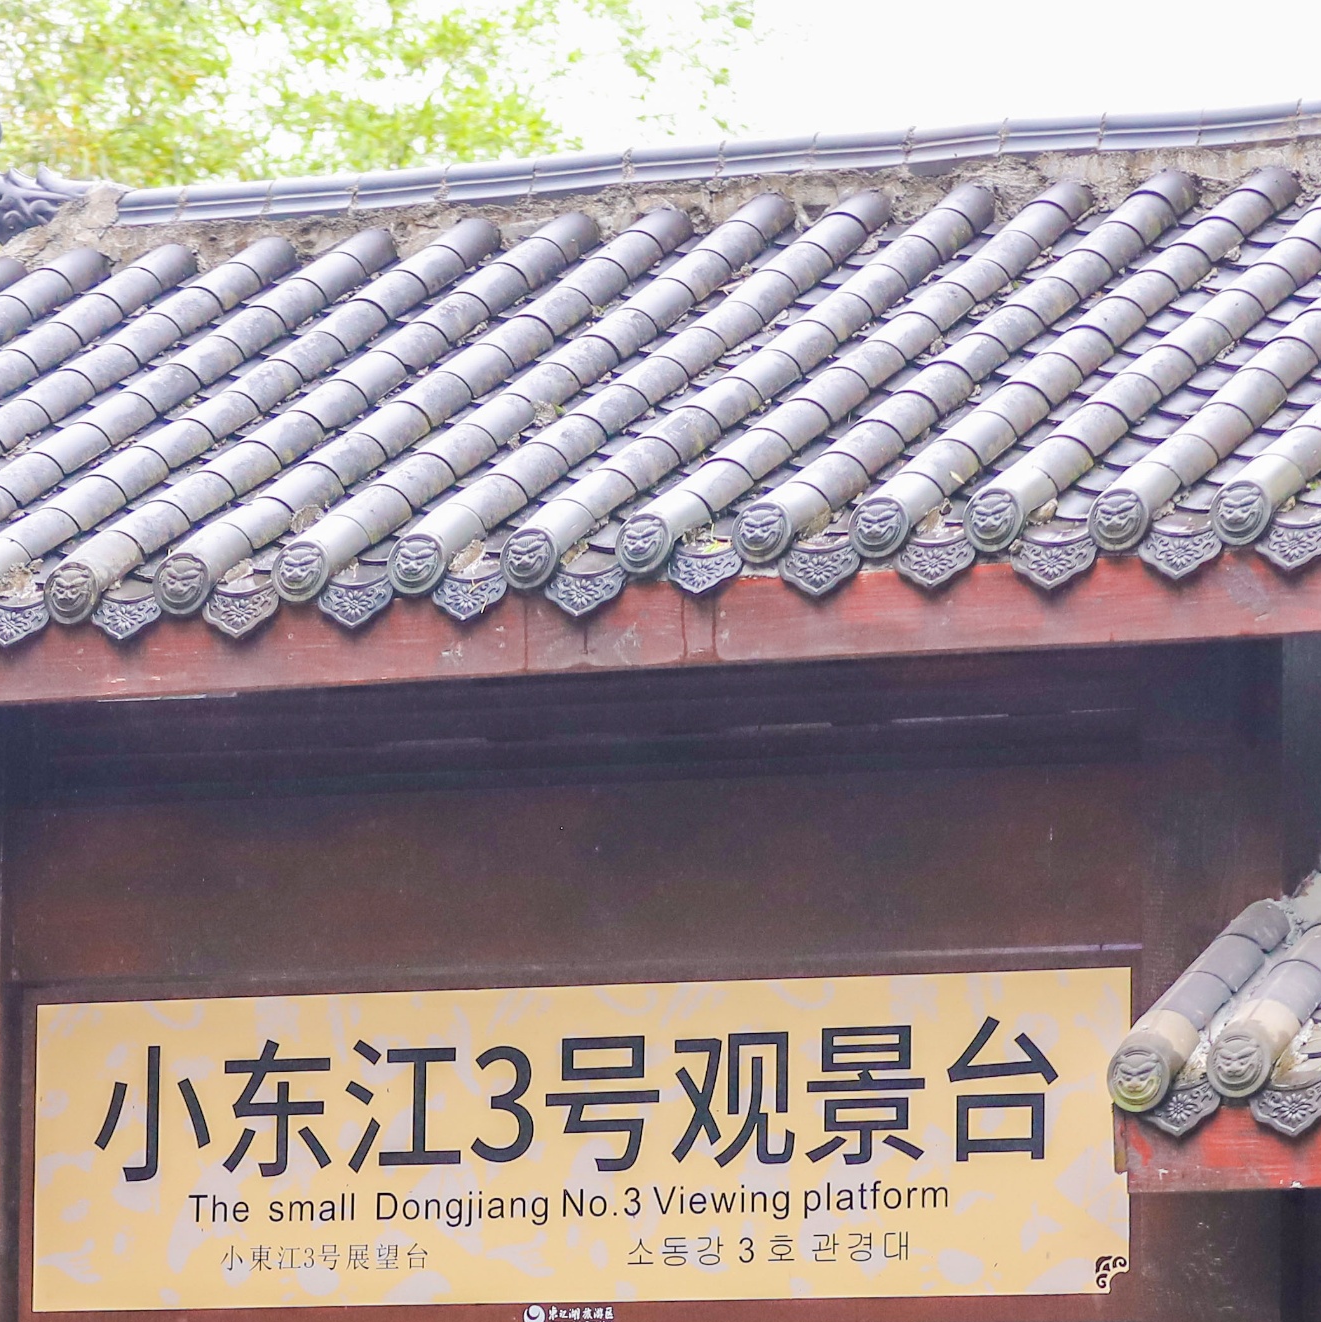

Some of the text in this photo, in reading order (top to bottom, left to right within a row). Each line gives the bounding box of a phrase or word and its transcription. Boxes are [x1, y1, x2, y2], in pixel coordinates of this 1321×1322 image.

[94, 1016, 1059, 1182] 小东江3号观景台
[189, 1180, 949, 1227] The small Dongjiang No.3 Viewing platform
[220, 1243, 429, 1271] 小東江3号展望台
[627, 1230, 910, 1267] 소동강 3 호 관경대
